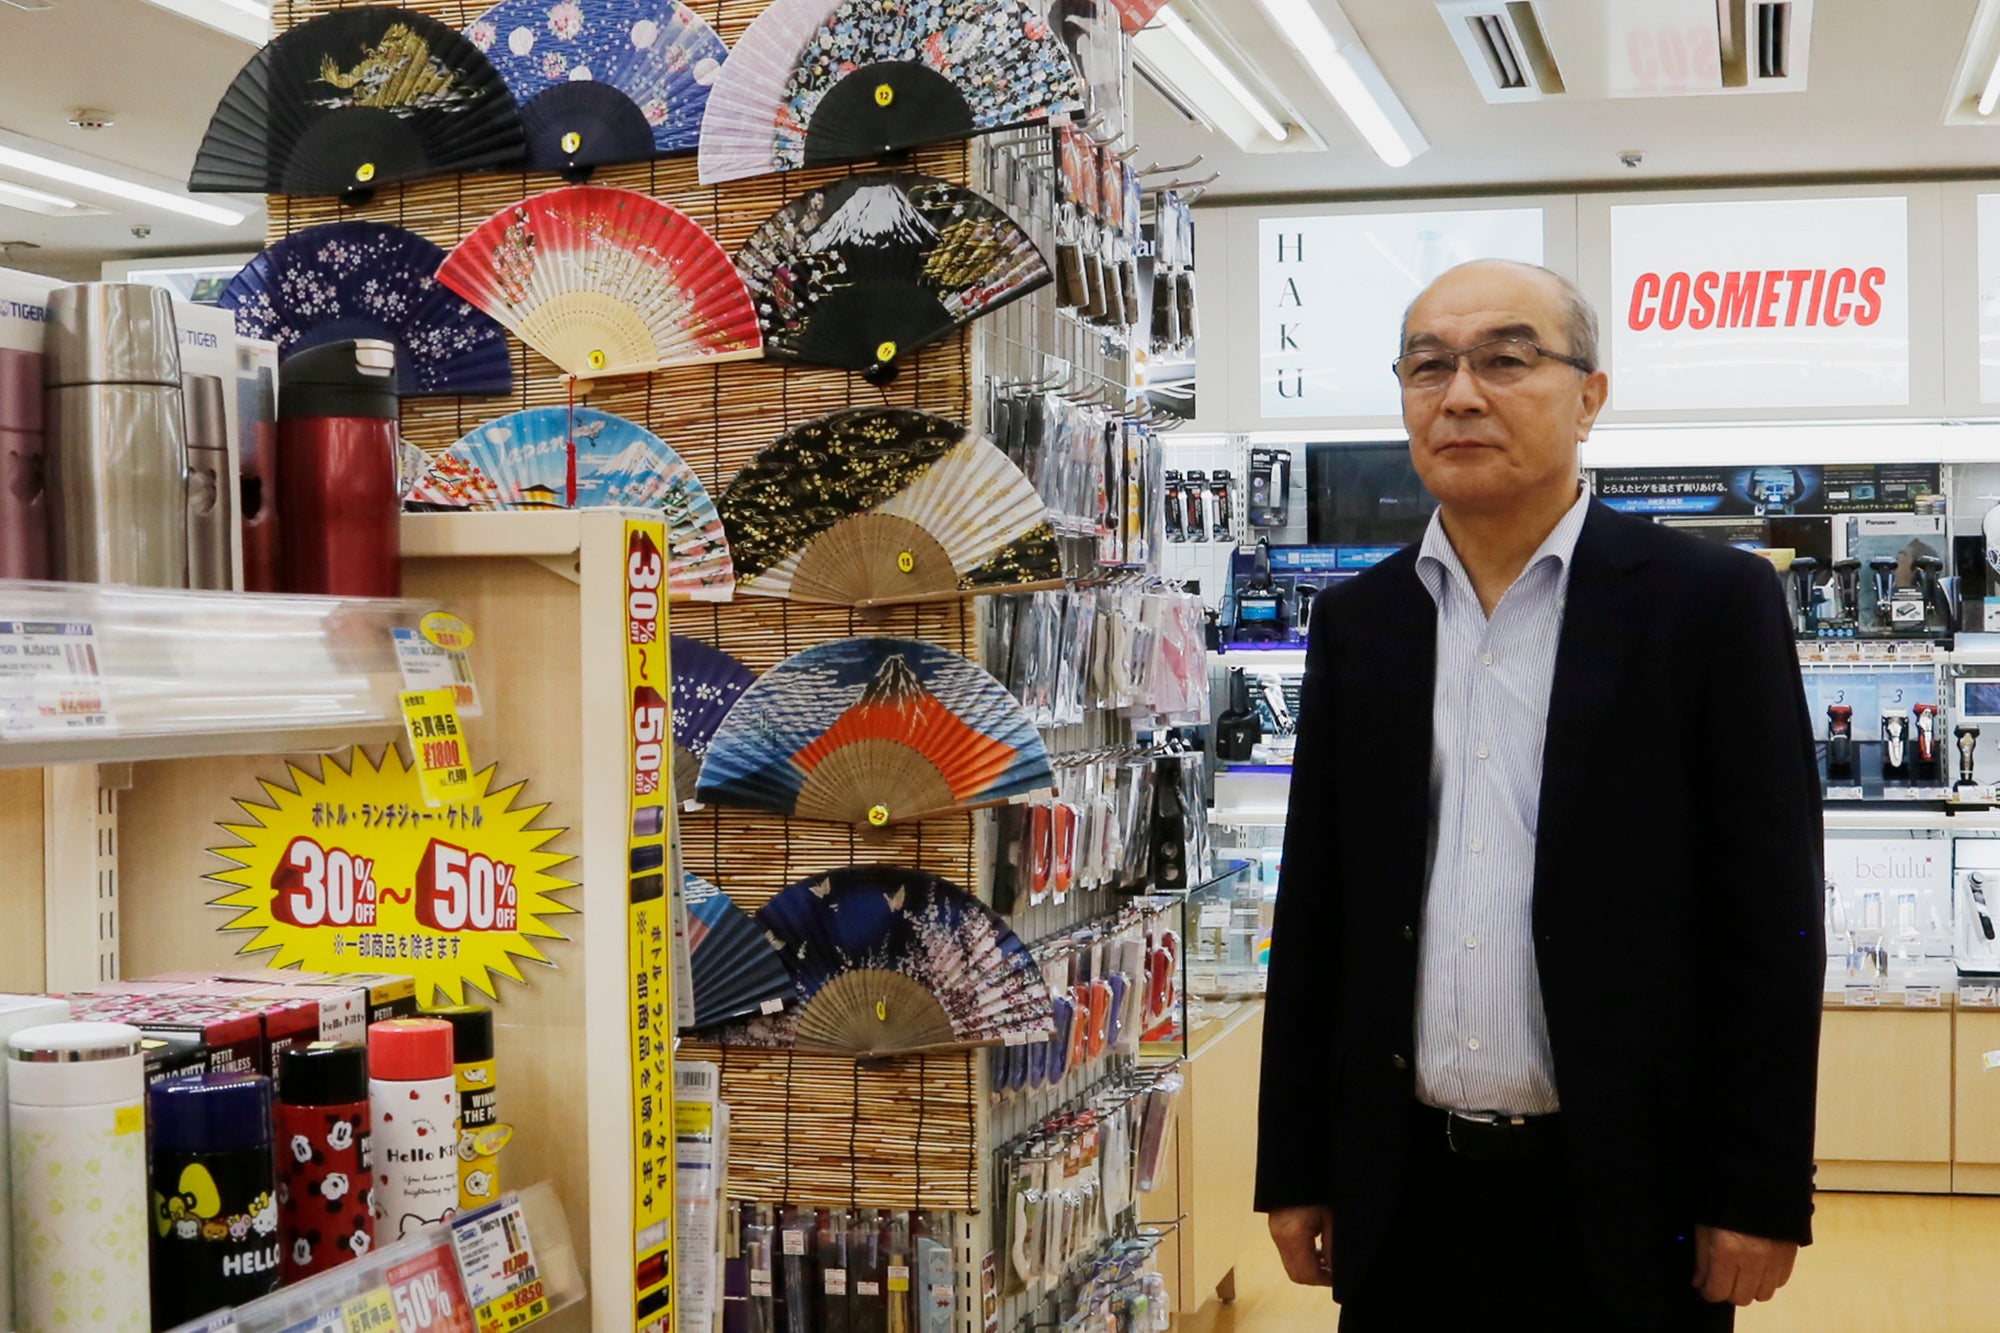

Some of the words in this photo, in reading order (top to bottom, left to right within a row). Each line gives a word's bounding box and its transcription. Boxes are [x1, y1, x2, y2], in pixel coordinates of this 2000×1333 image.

[10, 301, 45, 322] TIGER
[1628, 267, 1886, 331] COSMETICS
[1276, 233, 1304, 399] HAKU
[187, 330, 218, 348] TIGER
[629, 551, 661, 643] 30%
[1834, 690, 1845, 704] 3
[1893, 688, 1904, 703] 3
[411, 714, 458, 738] お買得品
[1236, 732, 1245, 743] 7
[423, 740, 460, 769] ¥1800
[634, 706, 665, 792] 50%
[312, 802, 483, 829] ボトル・ランチジャー・ケトル
[290, 839, 375, 926] 30%
[355, 902, 375, 924] OFF
[433, 843, 515, 930] 50%
[496, 908, 516, 927] OFF
[334, 933, 461, 959] ※一部商品を除きます
[211, 1049, 233, 1065] PETIT
[211, 1057, 252, 1074] STAINLESS
[464, 1108, 485, 1123] THE
[387, 1148, 435, 1162] Hello
[223, 1243, 281, 1277] HELLO
[393, 1270, 452, 1333] 50%
